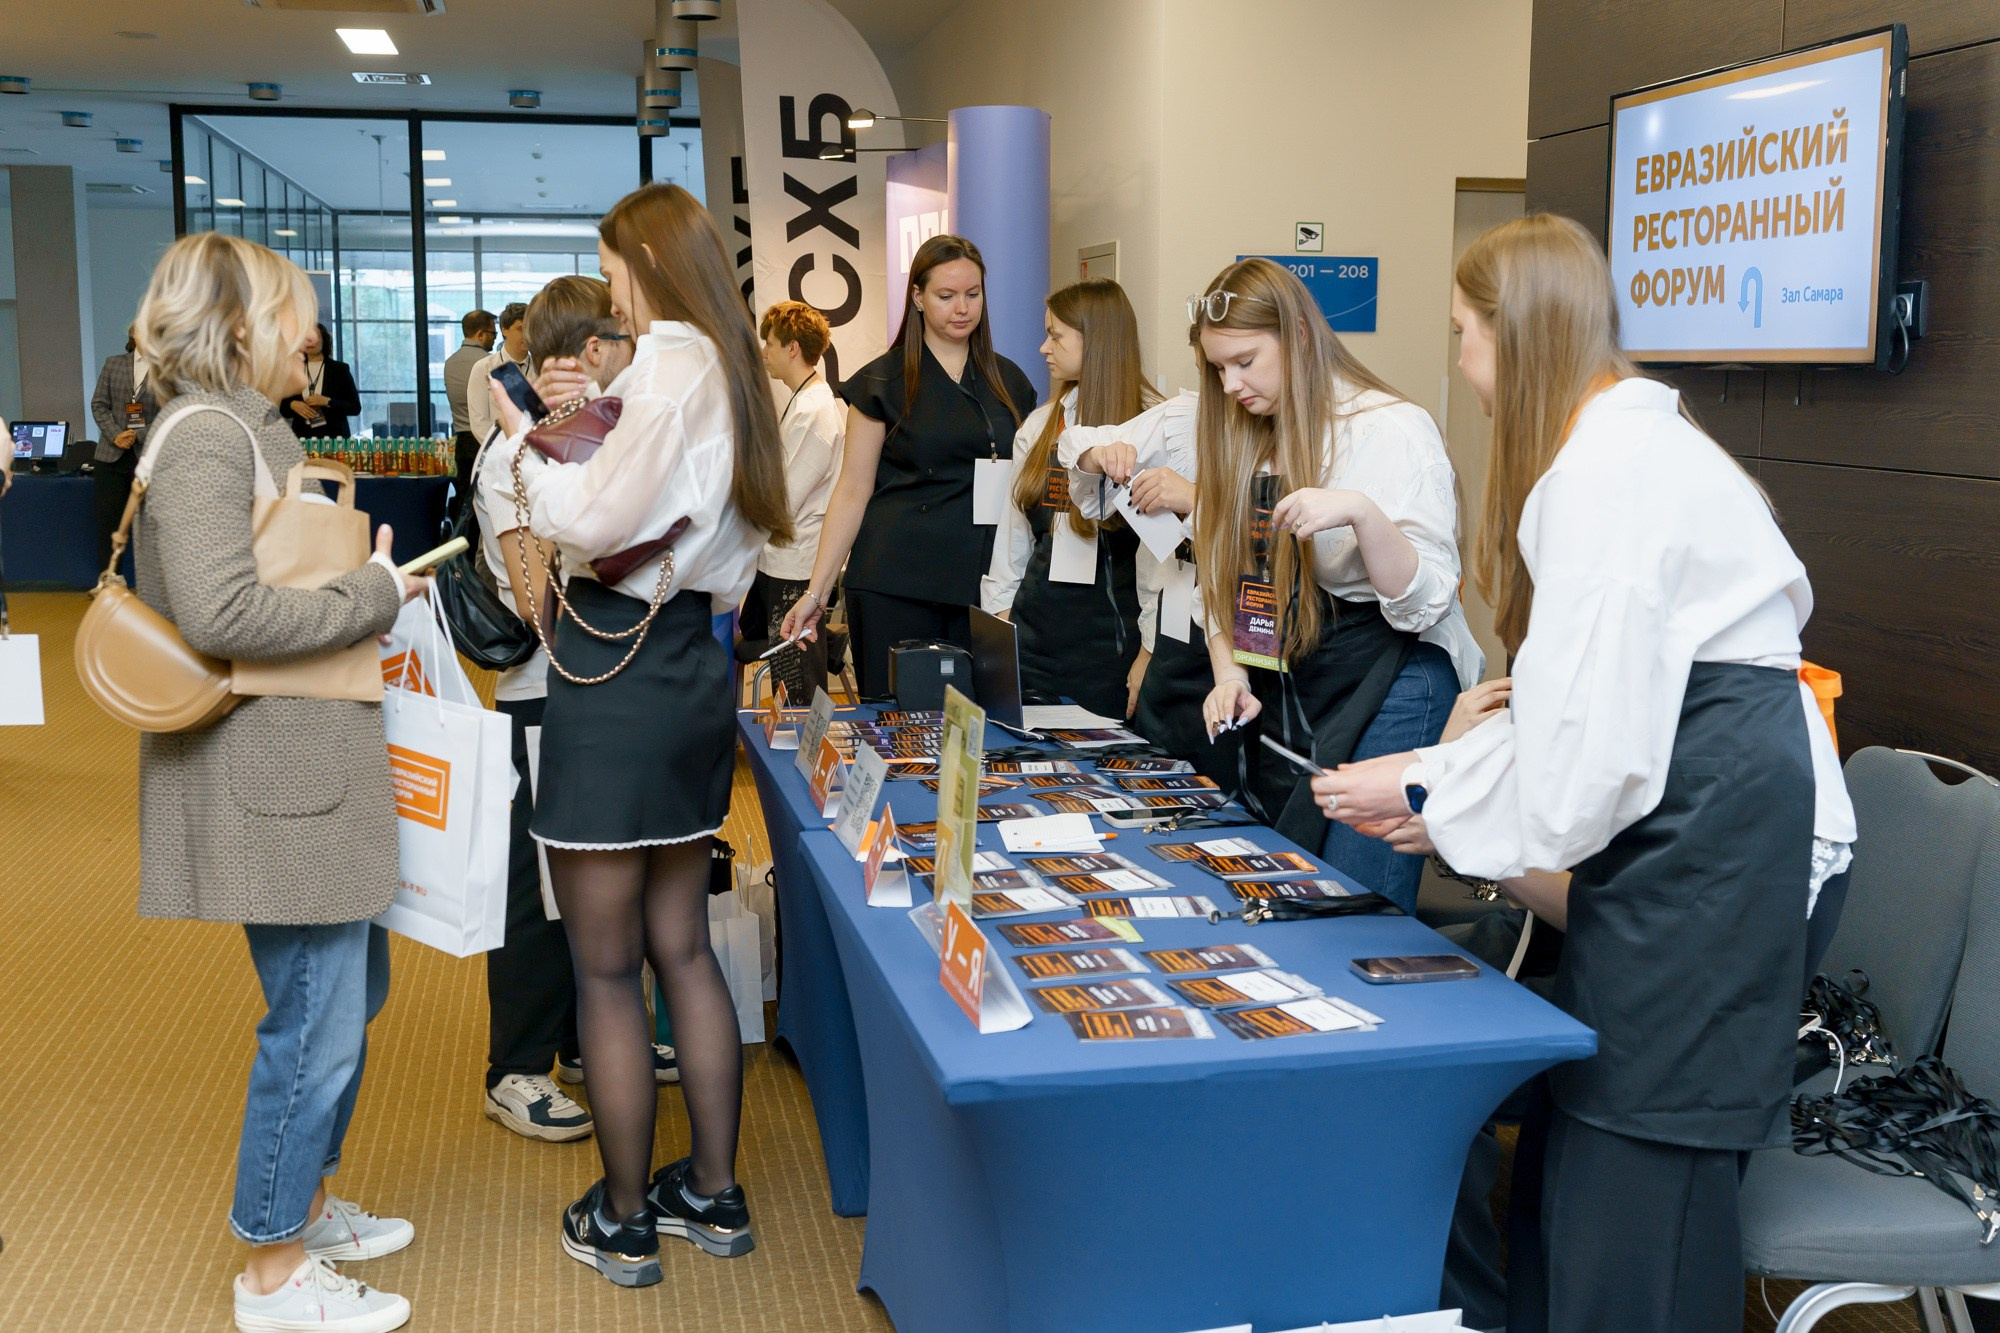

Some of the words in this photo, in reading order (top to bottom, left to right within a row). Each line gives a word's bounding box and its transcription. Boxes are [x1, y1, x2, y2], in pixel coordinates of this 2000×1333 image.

[1635, 106, 1849, 195] ЕВРАЗИЙСКИЙ
[1633, 175, 1845, 253] РЕСТОРАННЫЙ
[1288, 264, 1315, 278] 201
[1338, 265, 1369, 279] 208
[1630, 264, 1725, 309] ФОРУМ
[1781, 287, 1800, 304] Зал
[1803, 285, 1844, 305] Самара
[1248, 625, 1274, 635] ДЕМИНА
[1250, 616, 1274, 628] ДАРЬЯ
